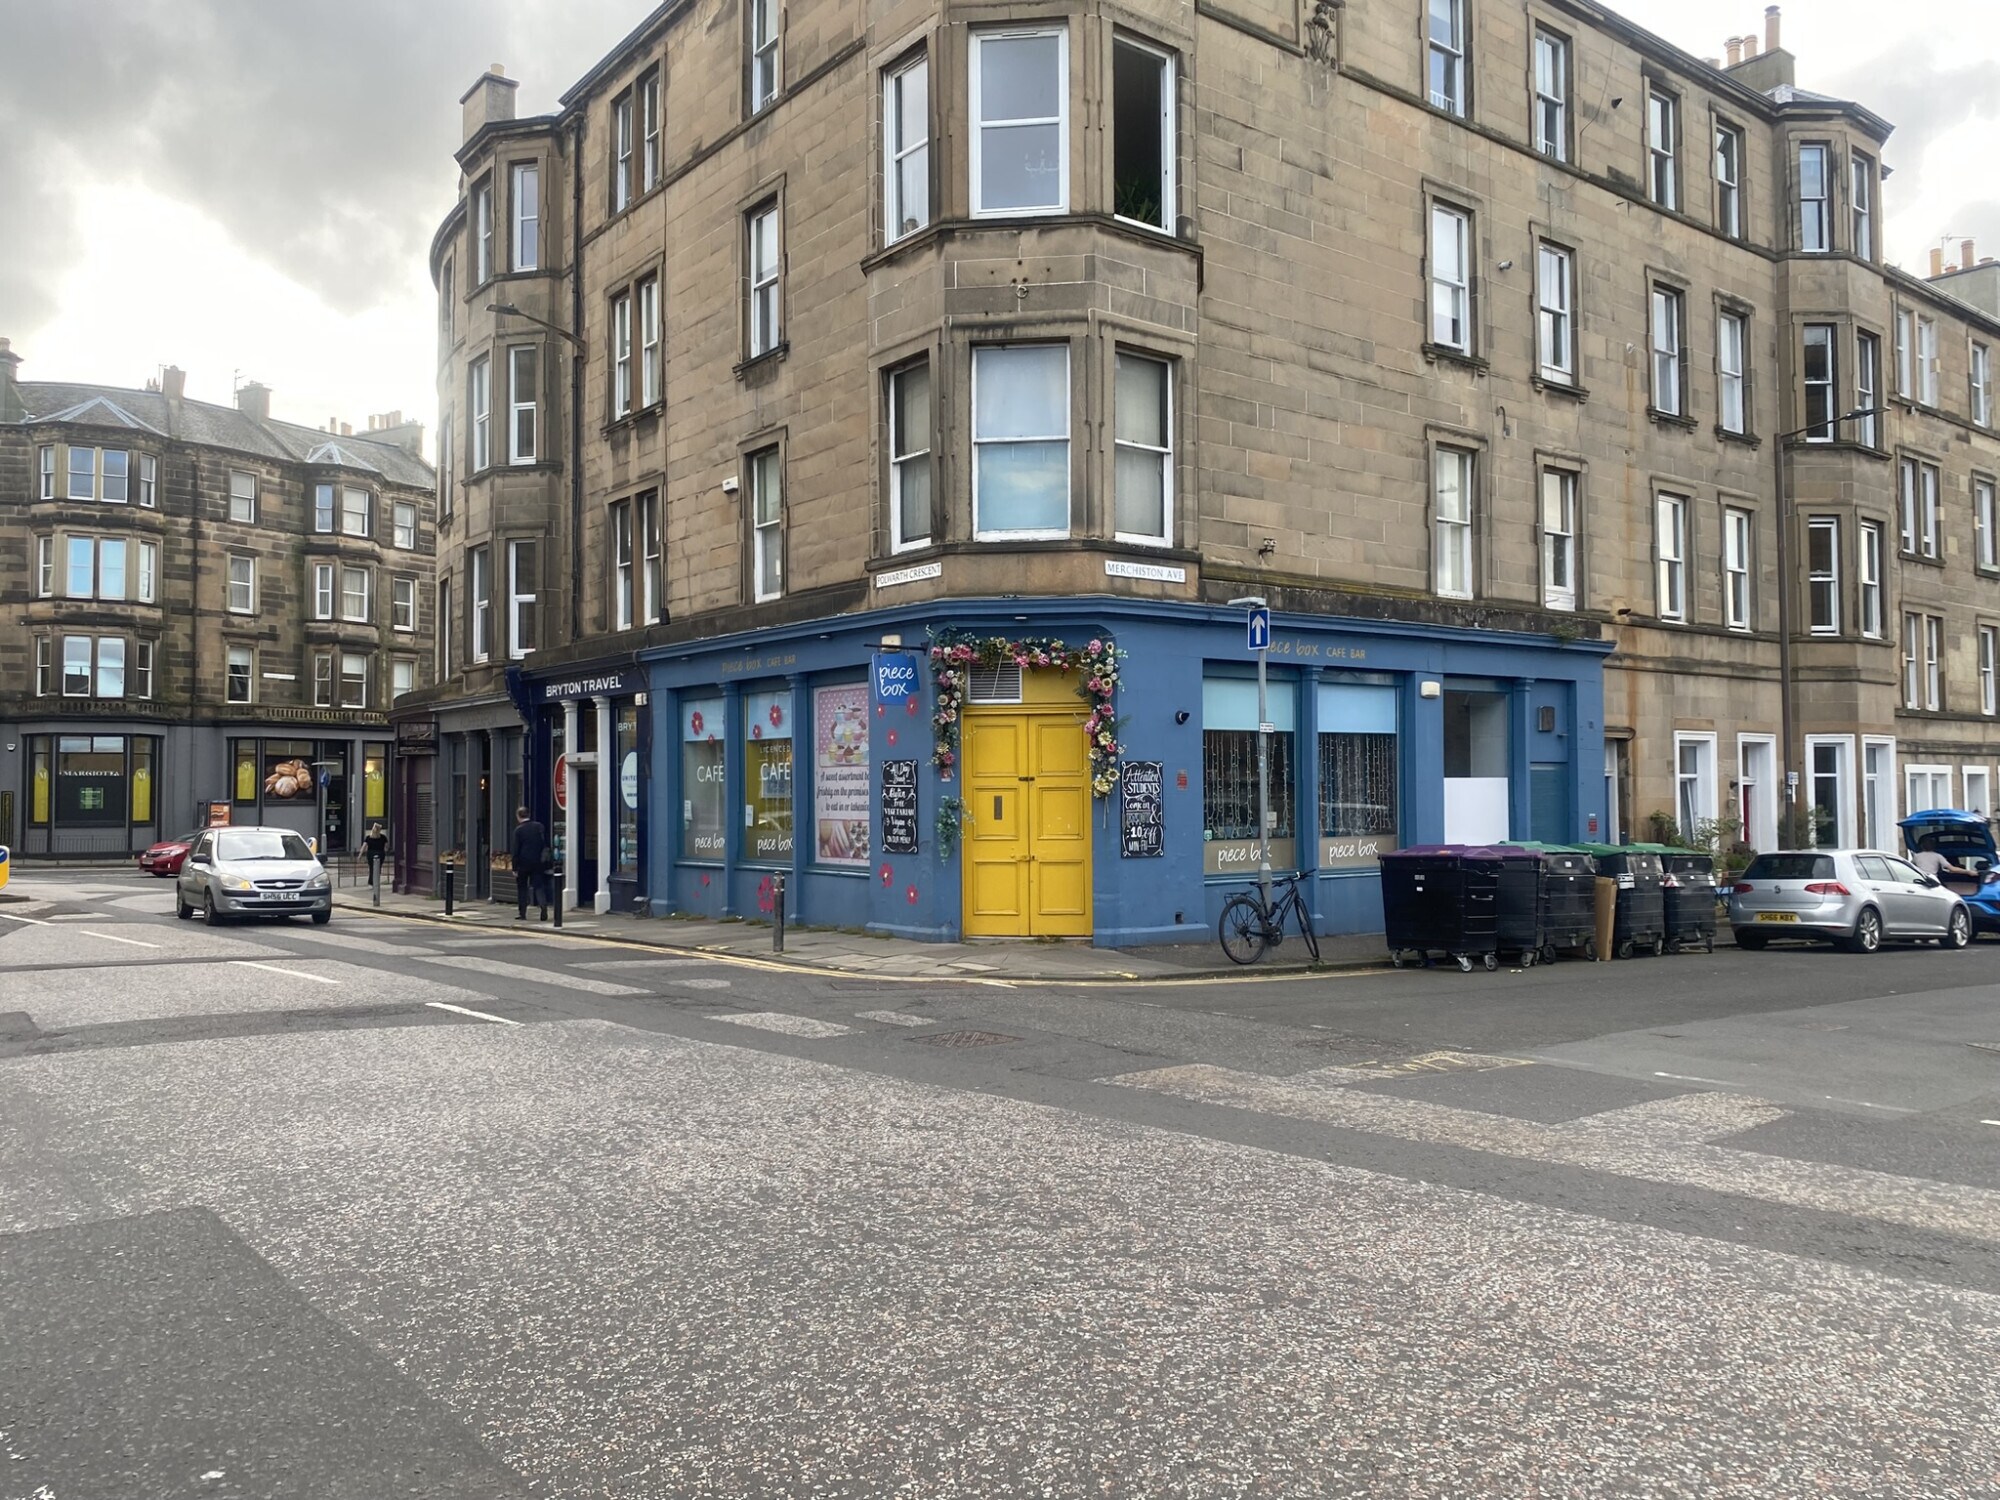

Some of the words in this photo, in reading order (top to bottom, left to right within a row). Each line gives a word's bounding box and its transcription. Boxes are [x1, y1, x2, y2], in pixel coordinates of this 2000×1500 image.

[878, 572, 909, 585] POLWARTH
[909, 564, 940, 579] CRESCENT
[1107, 563, 1163, 577] MERCHISTON
[1167, 570, 1183, 580] AVE
[1296, 639, 1319, 656] box
[1350, 648, 1366, 659] BAR
[746, 655, 761, 672] box
[784, 654, 796, 665] BAR
[879, 663, 914, 682] piece
[546, 681, 581, 697] BRYTON
[583, 675, 621, 692] TRAVEL
[881, 679, 909, 697] box
[696, 761, 724, 782] CAFÉ
[1124, 768, 1159, 782] Attention
[1127, 782, 1160, 794] STUDENTS
[1149, 803, 1161, 824] &
[695, 834, 712, 854] piece
[757, 836, 775, 857] piece
[778, 834, 794, 849] box
[1329, 843, 1355, 864] piece
[1358, 839, 1378, 857] box
[1218, 846, 1246, 869] piece
